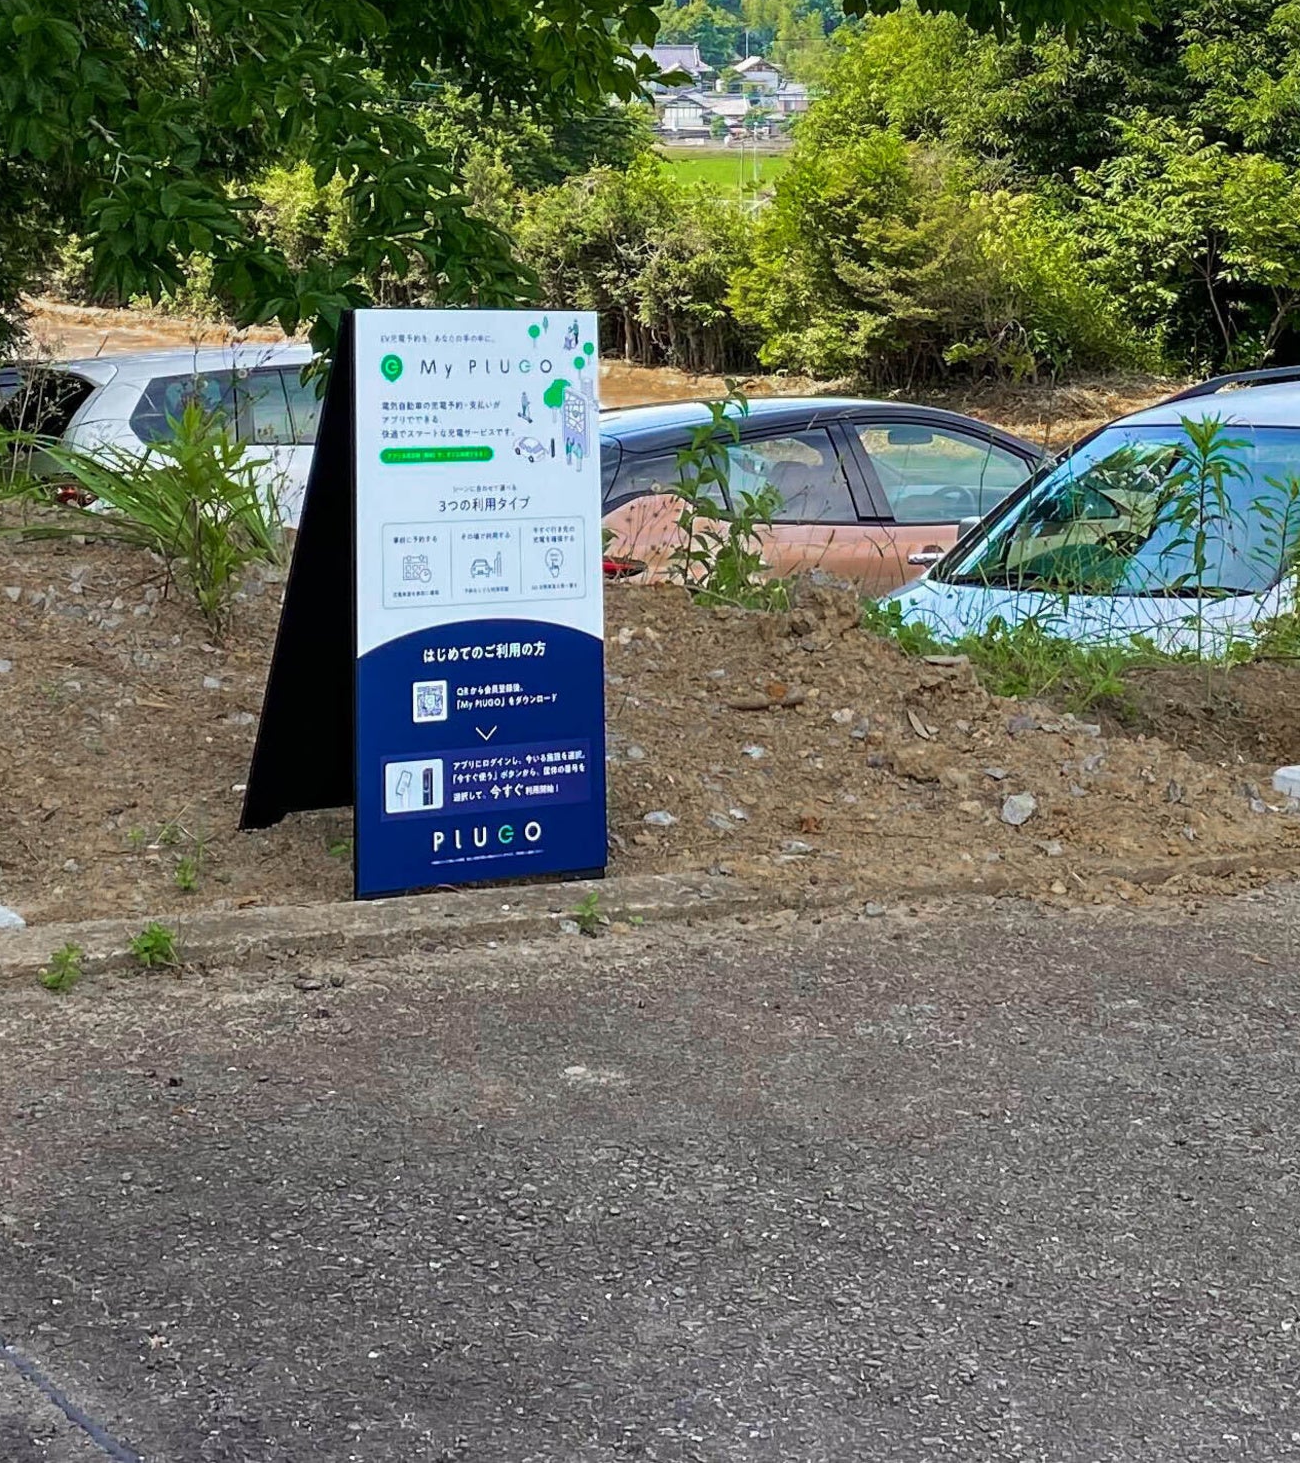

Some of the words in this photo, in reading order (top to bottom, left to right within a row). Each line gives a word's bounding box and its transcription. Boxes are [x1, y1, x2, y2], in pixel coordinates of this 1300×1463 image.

[420, 359, 453, 379] My
[438, 495, 531, 513] 3つの利用タイプ
[423, 640, 547, 663] はじめてのご利用の方
